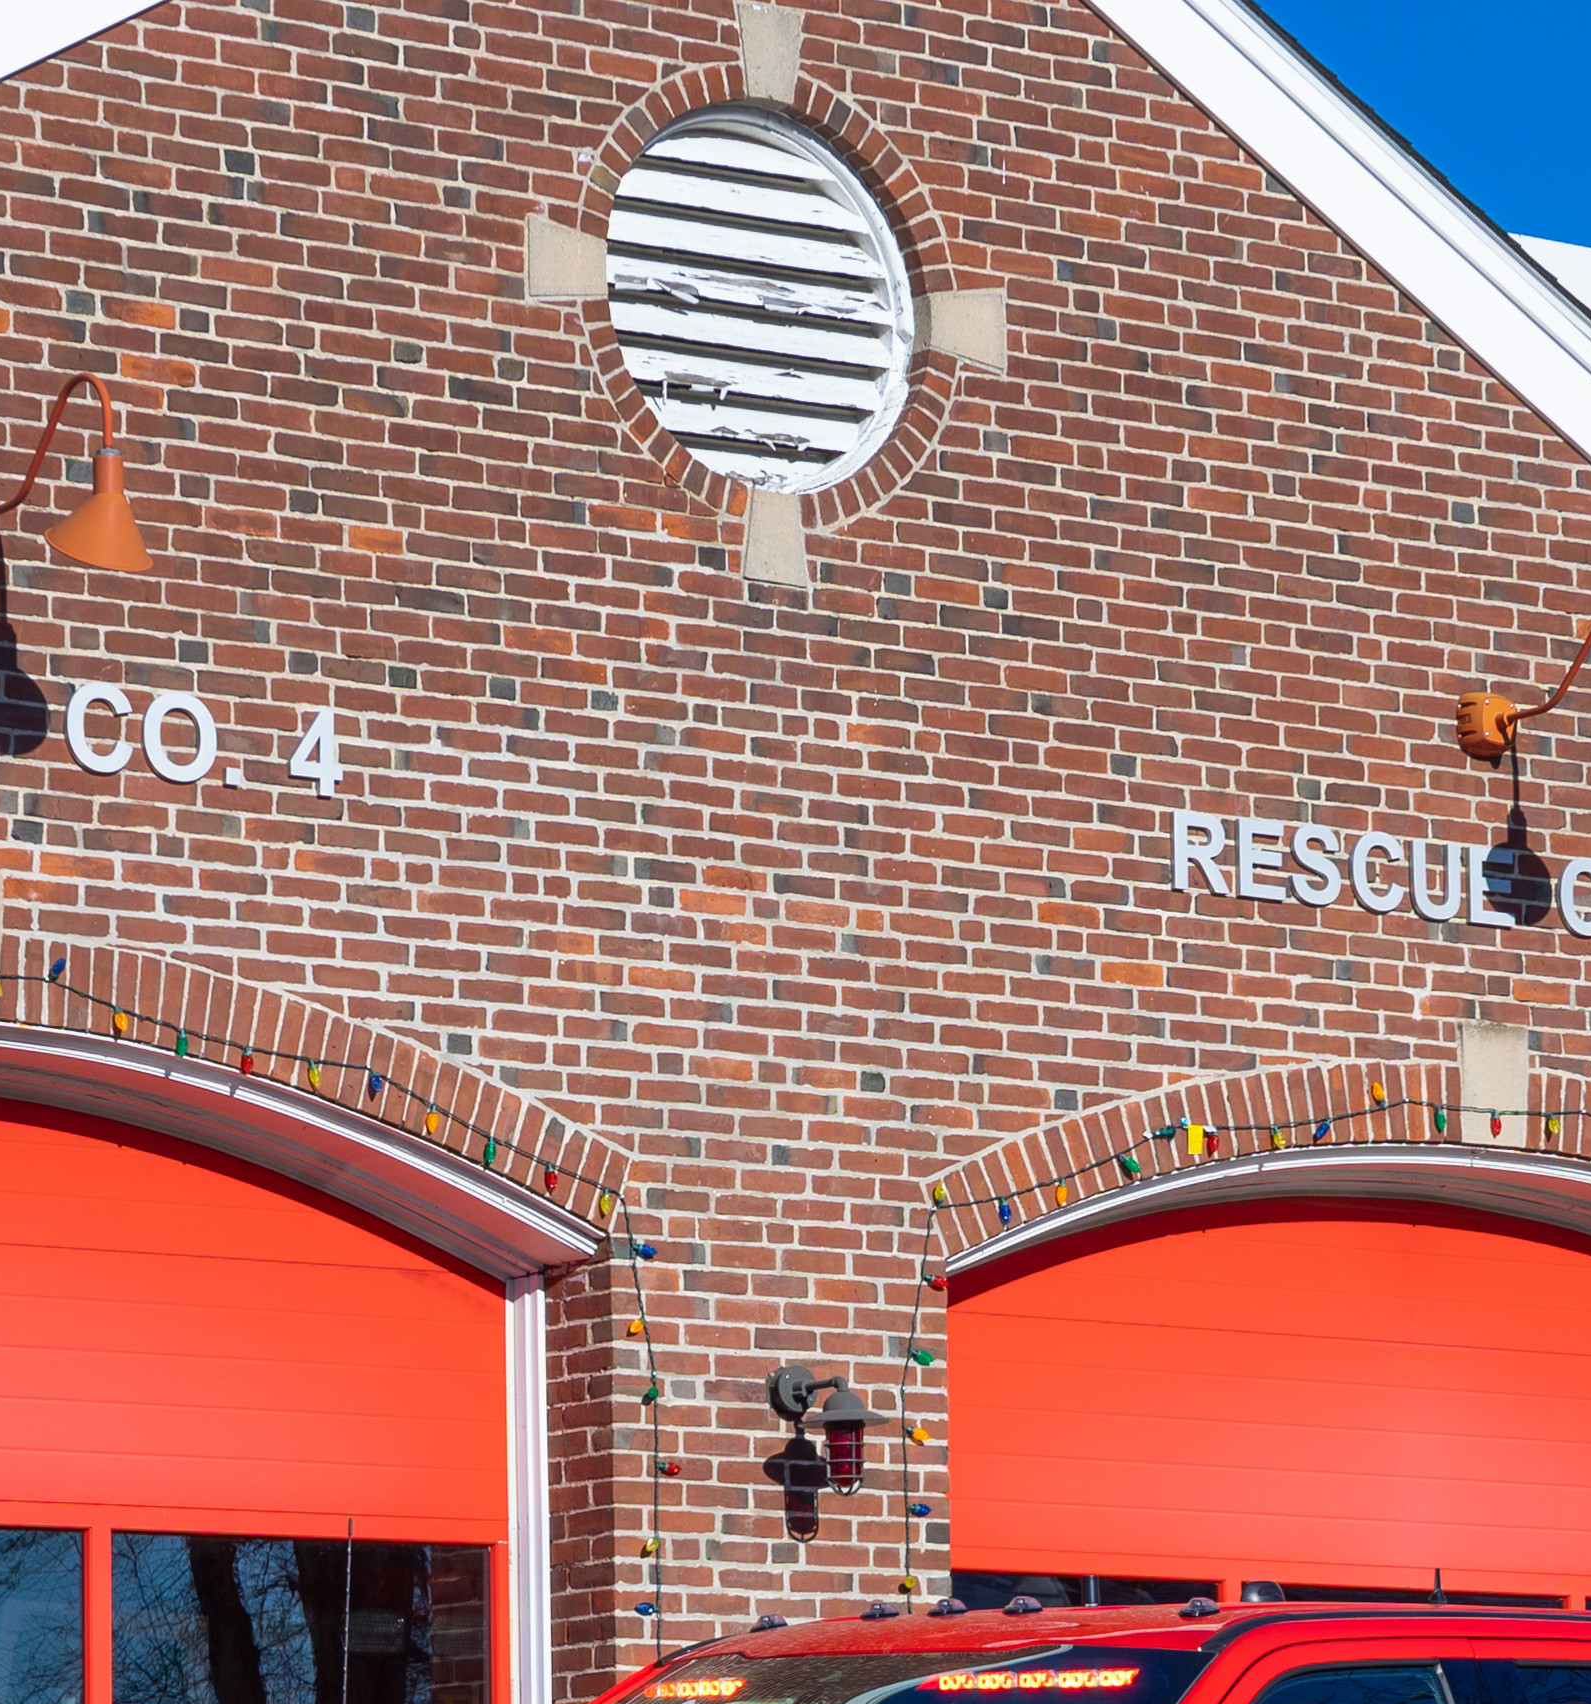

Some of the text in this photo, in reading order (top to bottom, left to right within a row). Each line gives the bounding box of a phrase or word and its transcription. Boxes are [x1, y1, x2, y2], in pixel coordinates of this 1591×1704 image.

[65, 682, 243, 788] CO.
[288, 708, 344, 799] 4
[1170, 810, 1516, 928] RESCUE
